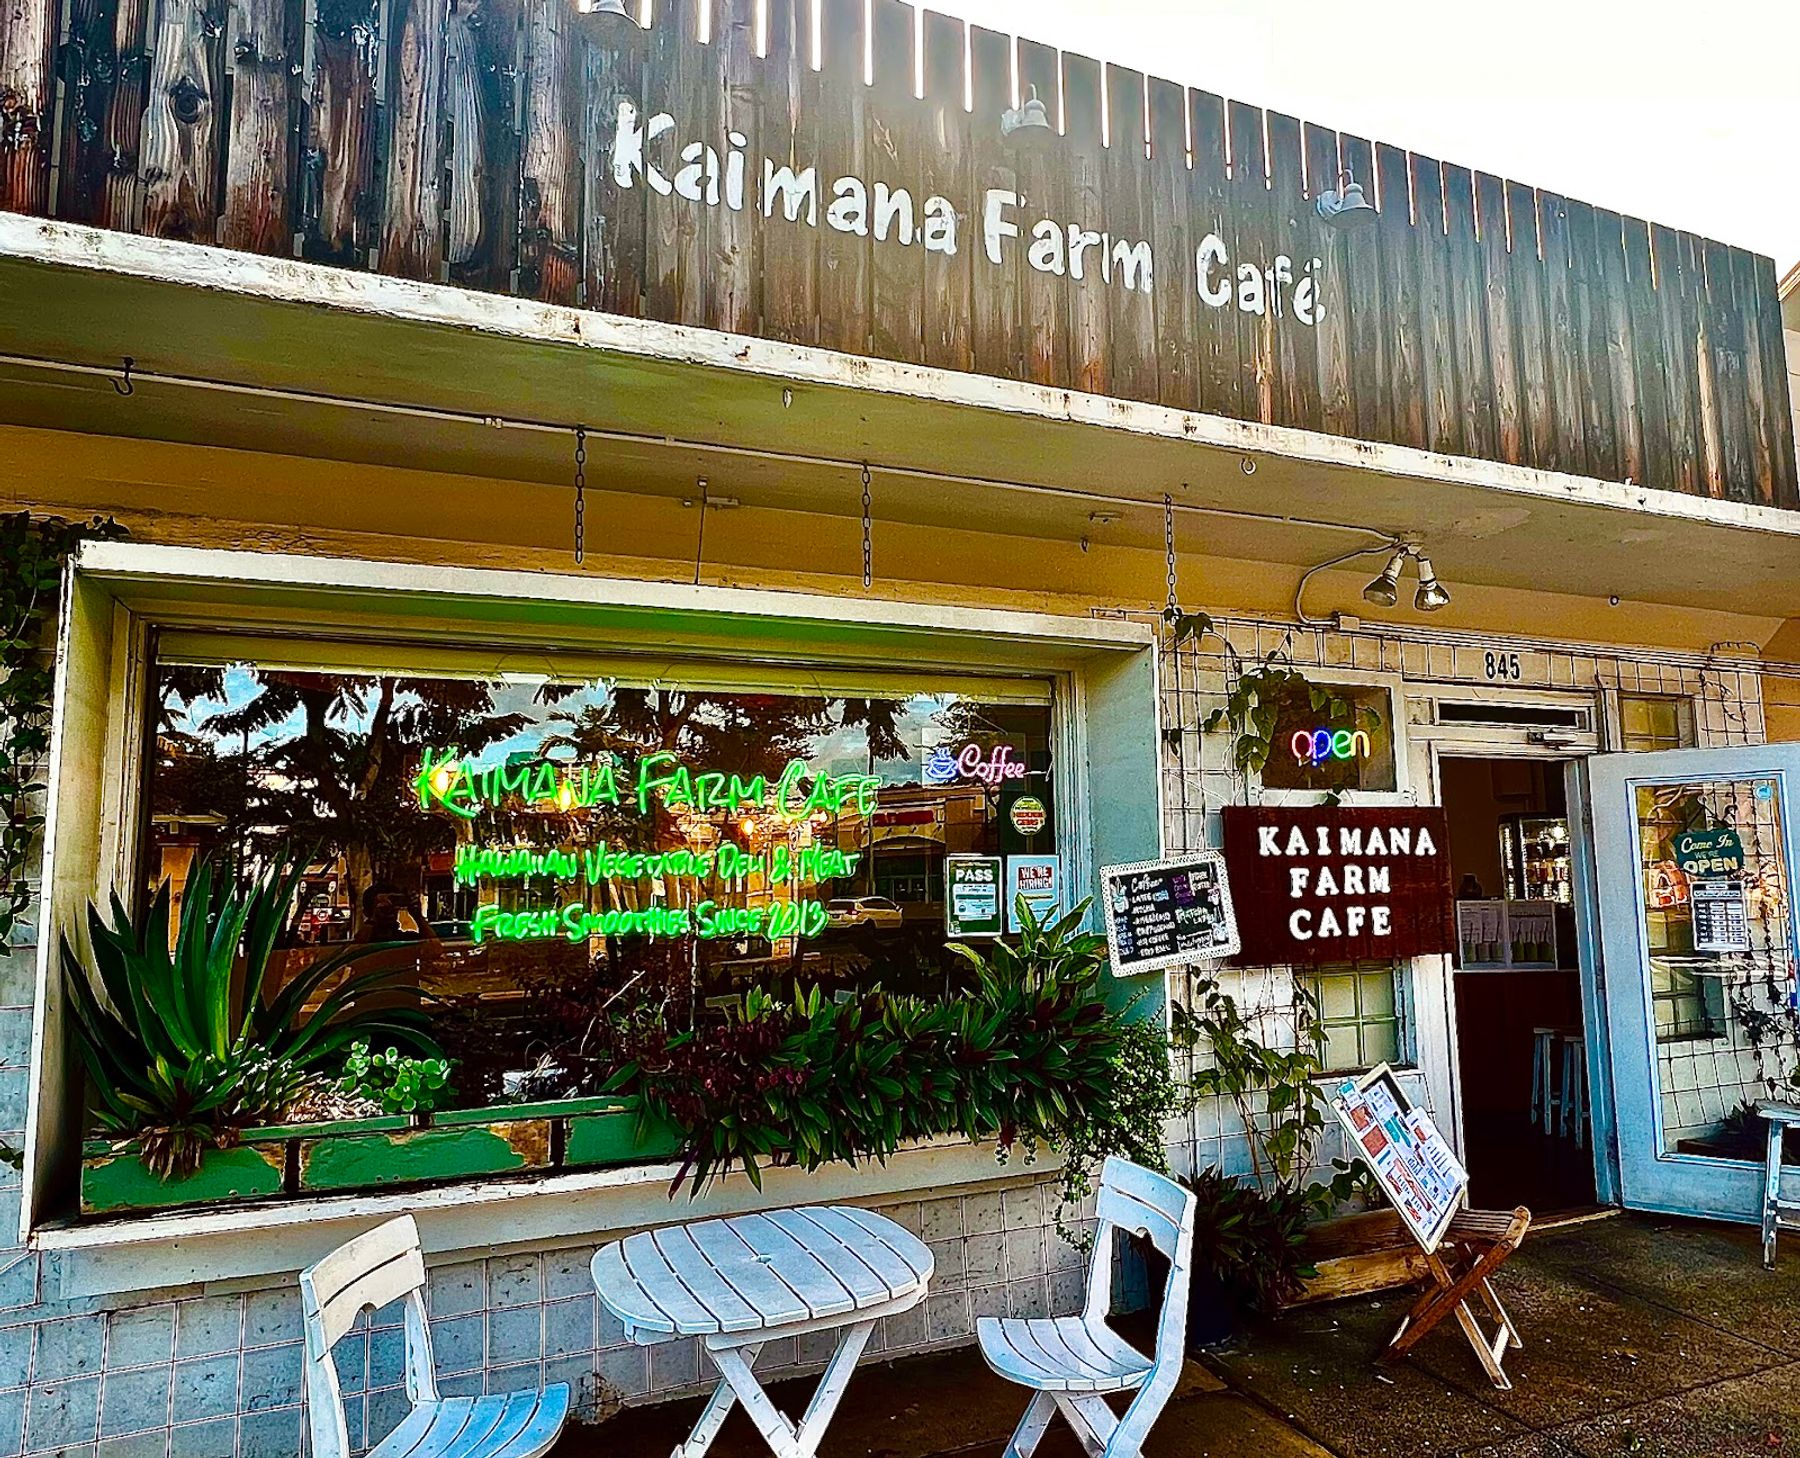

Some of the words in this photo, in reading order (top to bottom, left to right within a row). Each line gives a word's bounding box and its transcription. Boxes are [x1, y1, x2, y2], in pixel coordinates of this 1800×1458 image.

[611, 101, 958, 256] Kaimana
[983, 188, 1154, 295] Farm
[1195, 231, 1328, 327] Café
[1484, 651, 1521, 681] 845
[957, 743, 1026, 783] Coffee
[1291, 730, 1371, 766] open
[414, 745, 620, 819] KAIMANA
[638, 751, 766, 815] FARM
[777, 758, 881, 820] CAFE
[1257, 825, 1438, 857] KAIMANA
[1681, 837, 1713, 853] Come
[1716, 834, 1735, 848] In
[584, 840, 711, 884] VEGETABLE
[769, 846, 793, 884] &
[798, 840, 862, 884] MEAT
[955, 869, 994, 882] PASS
[1683, 857, 1738, 874] OPEN
[1020, 877, 1053, 890] HIRING!
[1289, 865, 1391, 898] FARM
[471, 904, 558, 944] FRESH
[562, 902, 691, 943] SMOOTHIES
[696, 900, 762, 939] SINCE
[765, 899, 829, 941] 2013
[1288, 906, 1392, 940] CAFE
